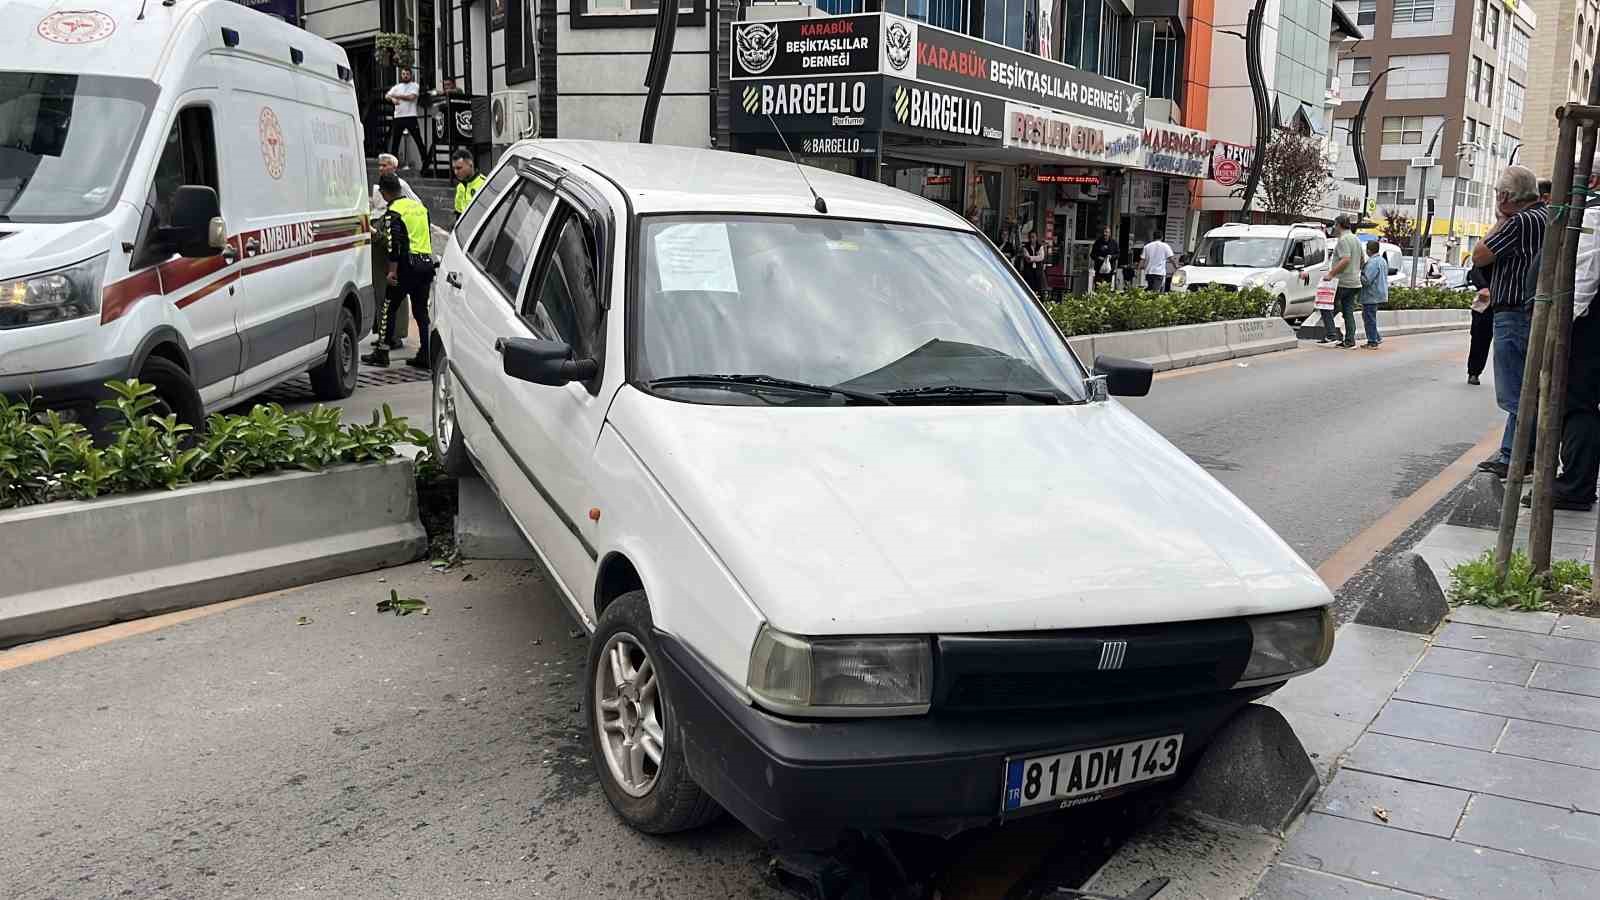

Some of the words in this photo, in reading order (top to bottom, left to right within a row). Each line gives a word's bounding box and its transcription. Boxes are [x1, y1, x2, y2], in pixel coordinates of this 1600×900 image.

[801, 20, 854, 36] KARABÜK
[786, 37, 868, 54] BEŞİKTAŞLILAR
[802, 52, 850, 68] DERNEĞİ
[917, 42, 987, 79] KARABÜK
[990, 60, 1079, 101] BEŞİKTAŞLILAR
[1080, 85, 1123, 113] DERNEĞİ
[762, 82, 866, 115] BARGELLO
[910, 88, 982, 136] BARGELLO
[812, 138, 860, 153] BARGELLO
[260, 221, 313, 254] AMBULANS
[1024, 759, 1061, 801] 81
[1066, 747, 1124, 794] ADM
[1131, 738, 1179, 779] 143
[1008, 788, 1020, 801] TR
